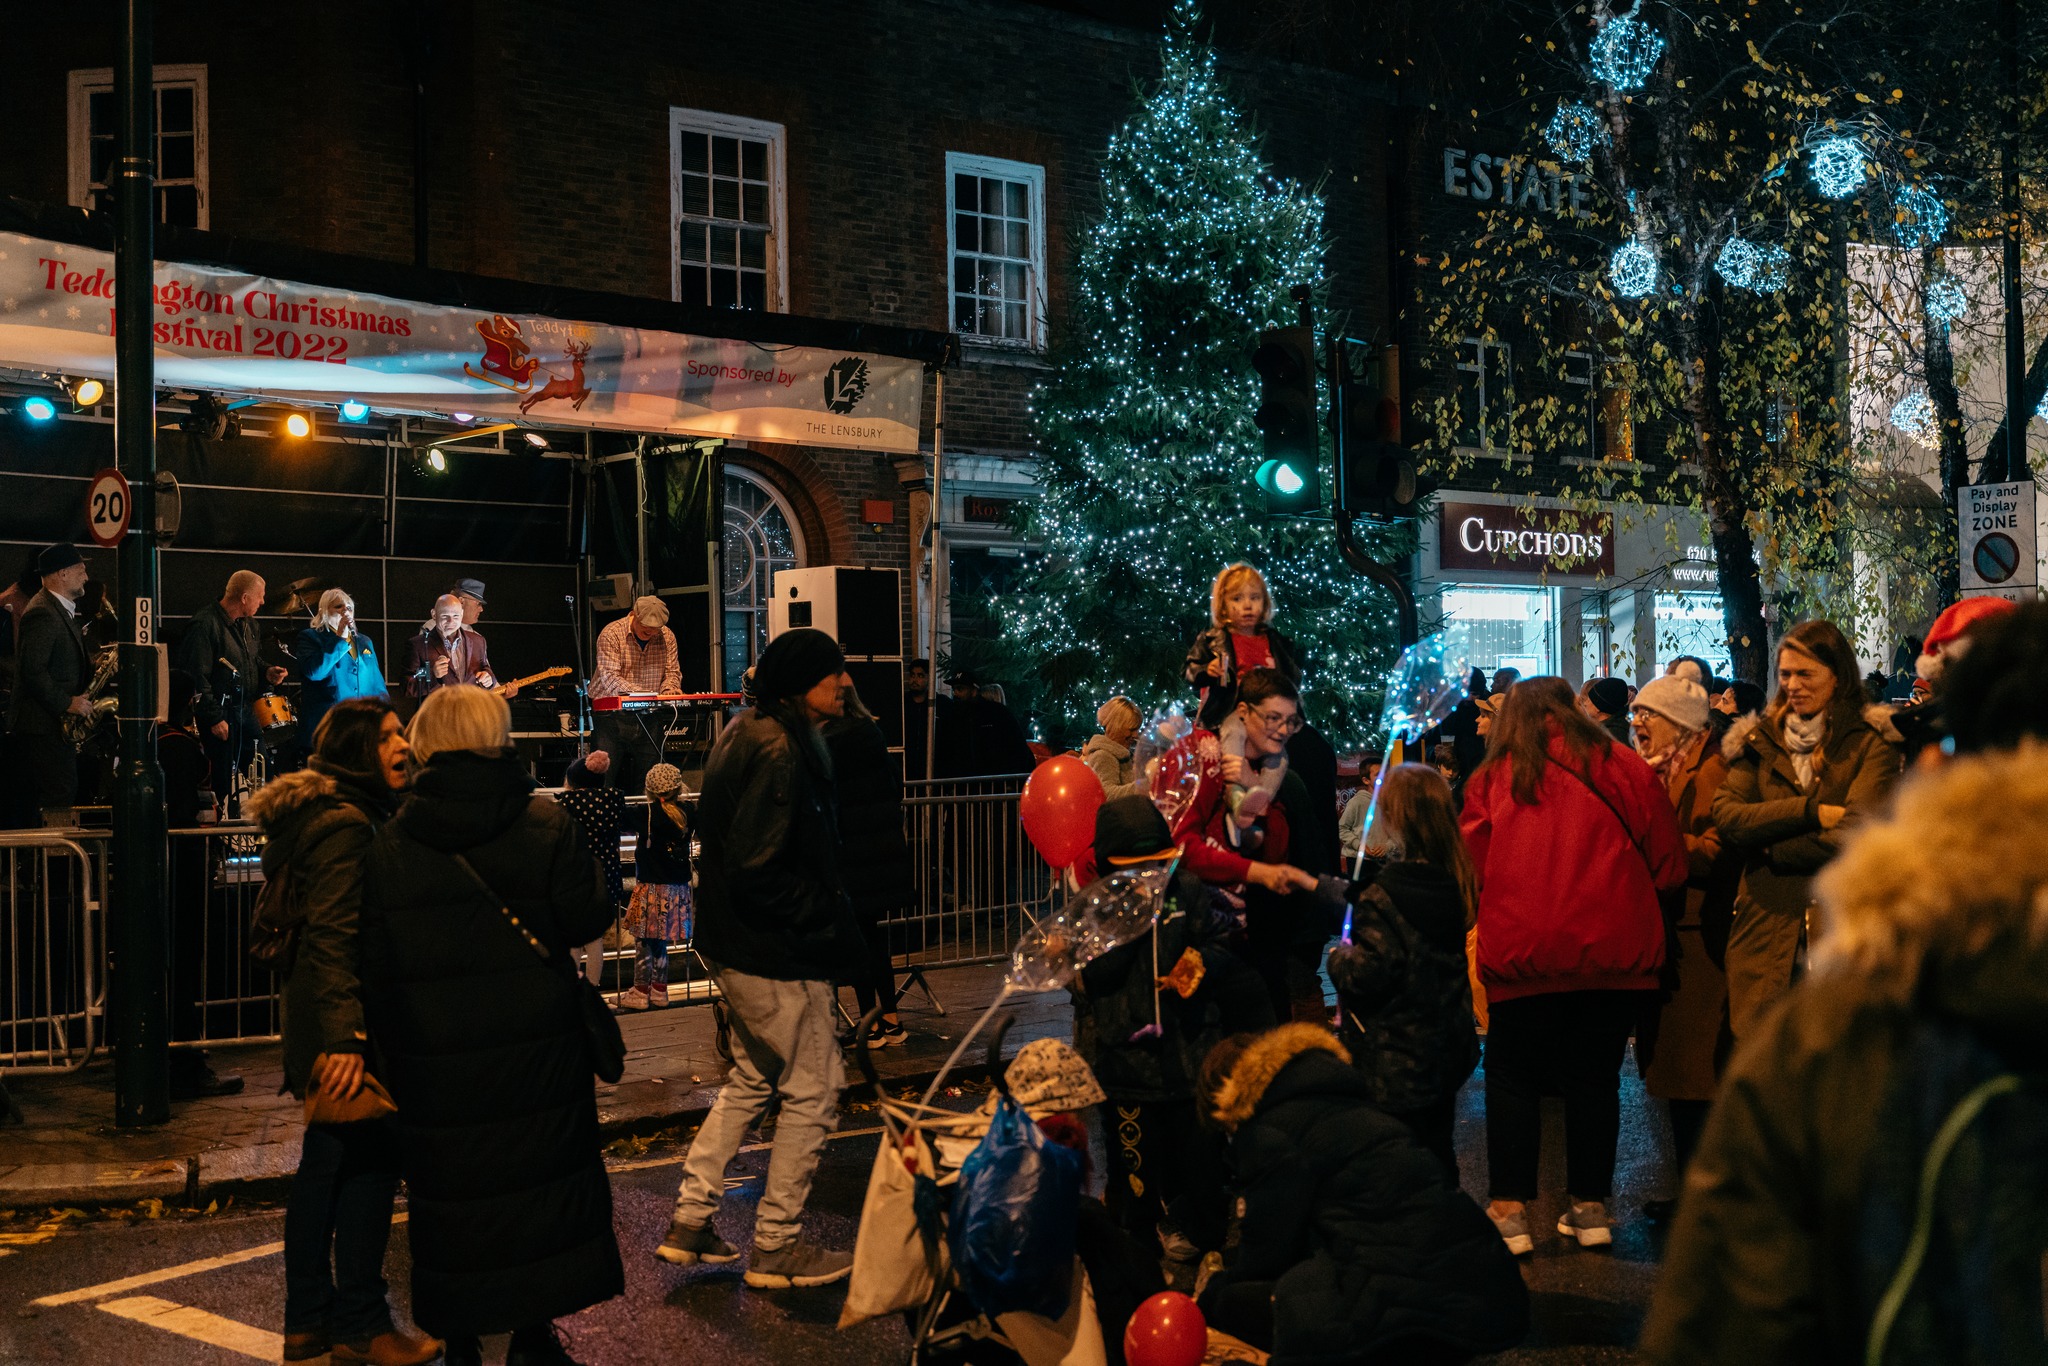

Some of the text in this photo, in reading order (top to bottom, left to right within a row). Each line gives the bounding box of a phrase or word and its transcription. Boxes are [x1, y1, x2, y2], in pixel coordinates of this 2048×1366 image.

[1443, 147, 1592, 219] ESTATE
[39, 258, 412, 337] Tedgton Christmas
[110, 307, 349, 365] stival 2022
[687, 359, 798, 388] Sponsored by
[806, 422, 883, 439] THE LENSBURY
[1971, 485, 2019, 500] Pay and
[93, 491, 124, 524] 20
[1973, 501, 2017, 514] Display
[1972, 514, 2018, 531] ZONE
